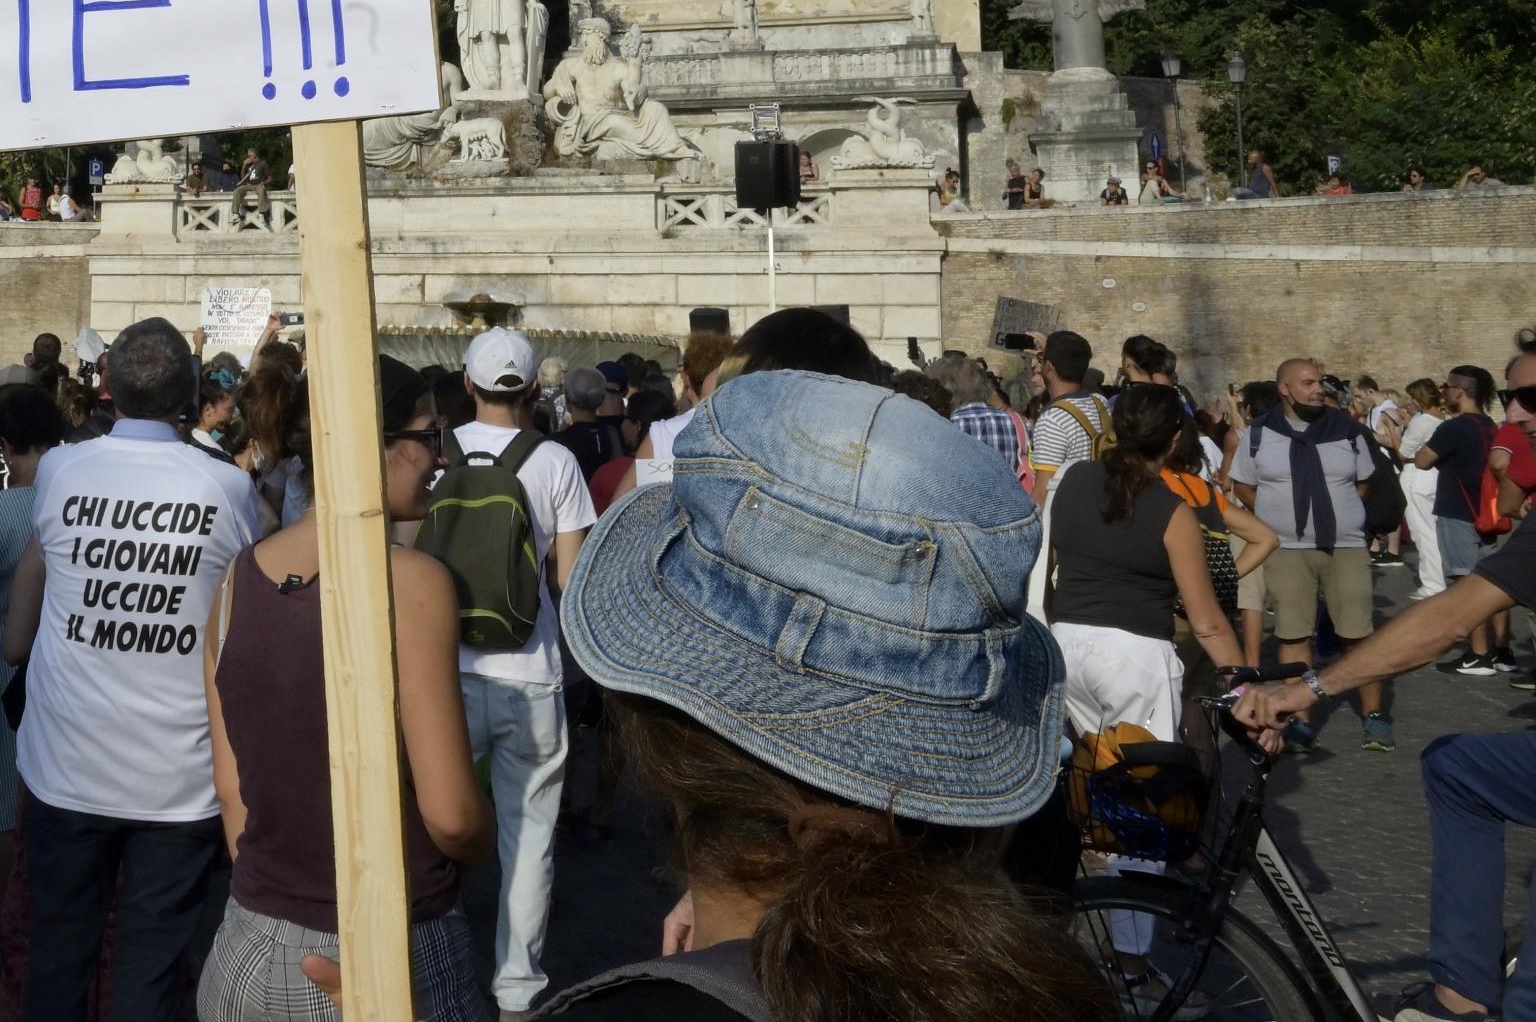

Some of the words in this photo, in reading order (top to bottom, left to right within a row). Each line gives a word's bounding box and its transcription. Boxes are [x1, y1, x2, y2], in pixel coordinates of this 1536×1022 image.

[93, 163, 101, 175] P
[62, 495, 109, 527] CHI
[111, 499, 218, 536] UCCIDE
[71, 536, 82, 564] I
[83, 538, 203, 577] GIOVANI
[83, 578, 187, 615] UCCIDE
[65, 613, 86, 643] IL
[90, 619, 197, 656] MONDO
